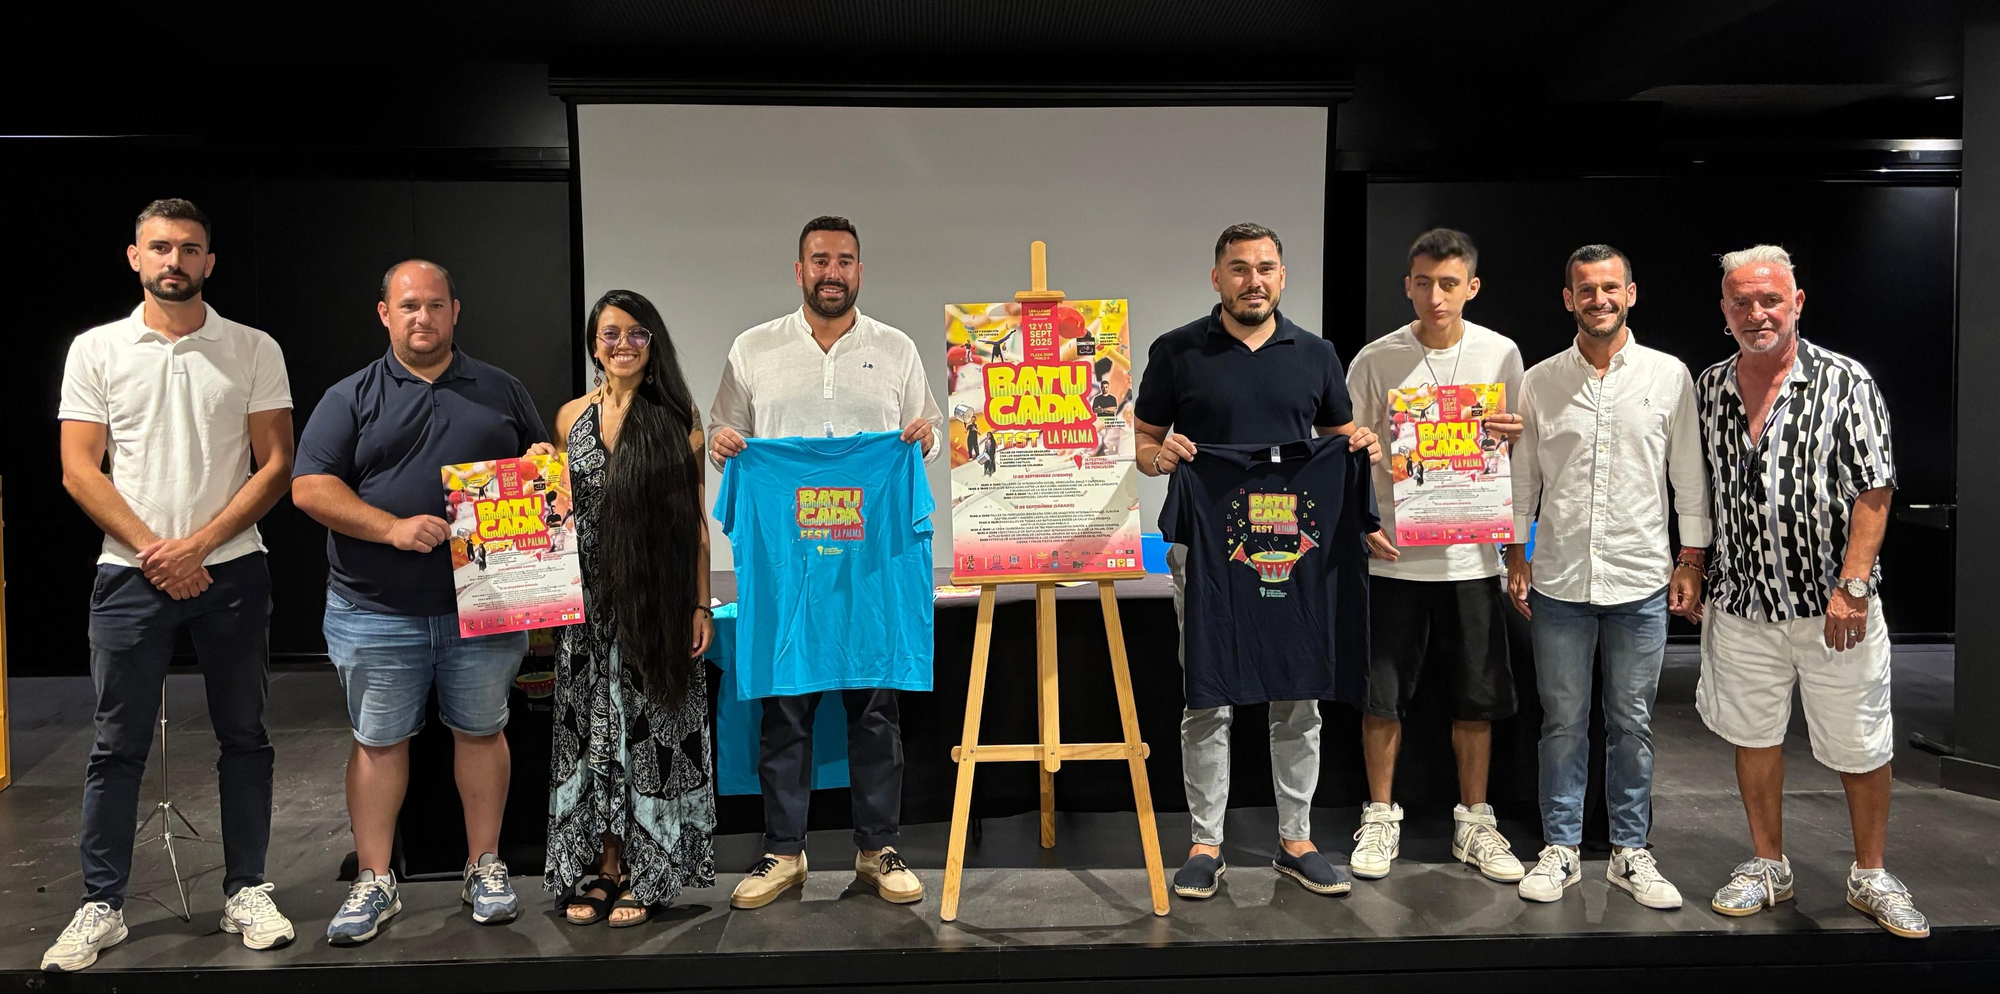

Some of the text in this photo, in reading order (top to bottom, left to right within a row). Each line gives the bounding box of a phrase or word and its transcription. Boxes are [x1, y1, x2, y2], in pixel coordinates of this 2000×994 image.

[1030, 330, 1052, 338] SEPT
[1030, 338, 1053, 346] 2025
[987, 365, 1087, 398] BATU
[989, 394, 1092, 425] CADA
[993, 429, 1093, 448] FEST LA PALMA
[1417, 422, 1477, 441] BATU
[1419, 439, 1480, 457] CADA
[1422, 458, 1482, 470] FEST LA PALMA
[476, 496, 541, 521] BATU
[799, 490, 860, 509] BATU
[1250, 495, 1295, 509] BATU
[799, 507, 861, 526] CADA
[1251, 508, 1296, 523] CADA
[479, 515, 546, 539] CADA
[800, 528, 861, 539] FEST LA PALMA
[1251, 525, 1273, 533] FEST
[483, 536, 548, 552] FEST LA PALMA
